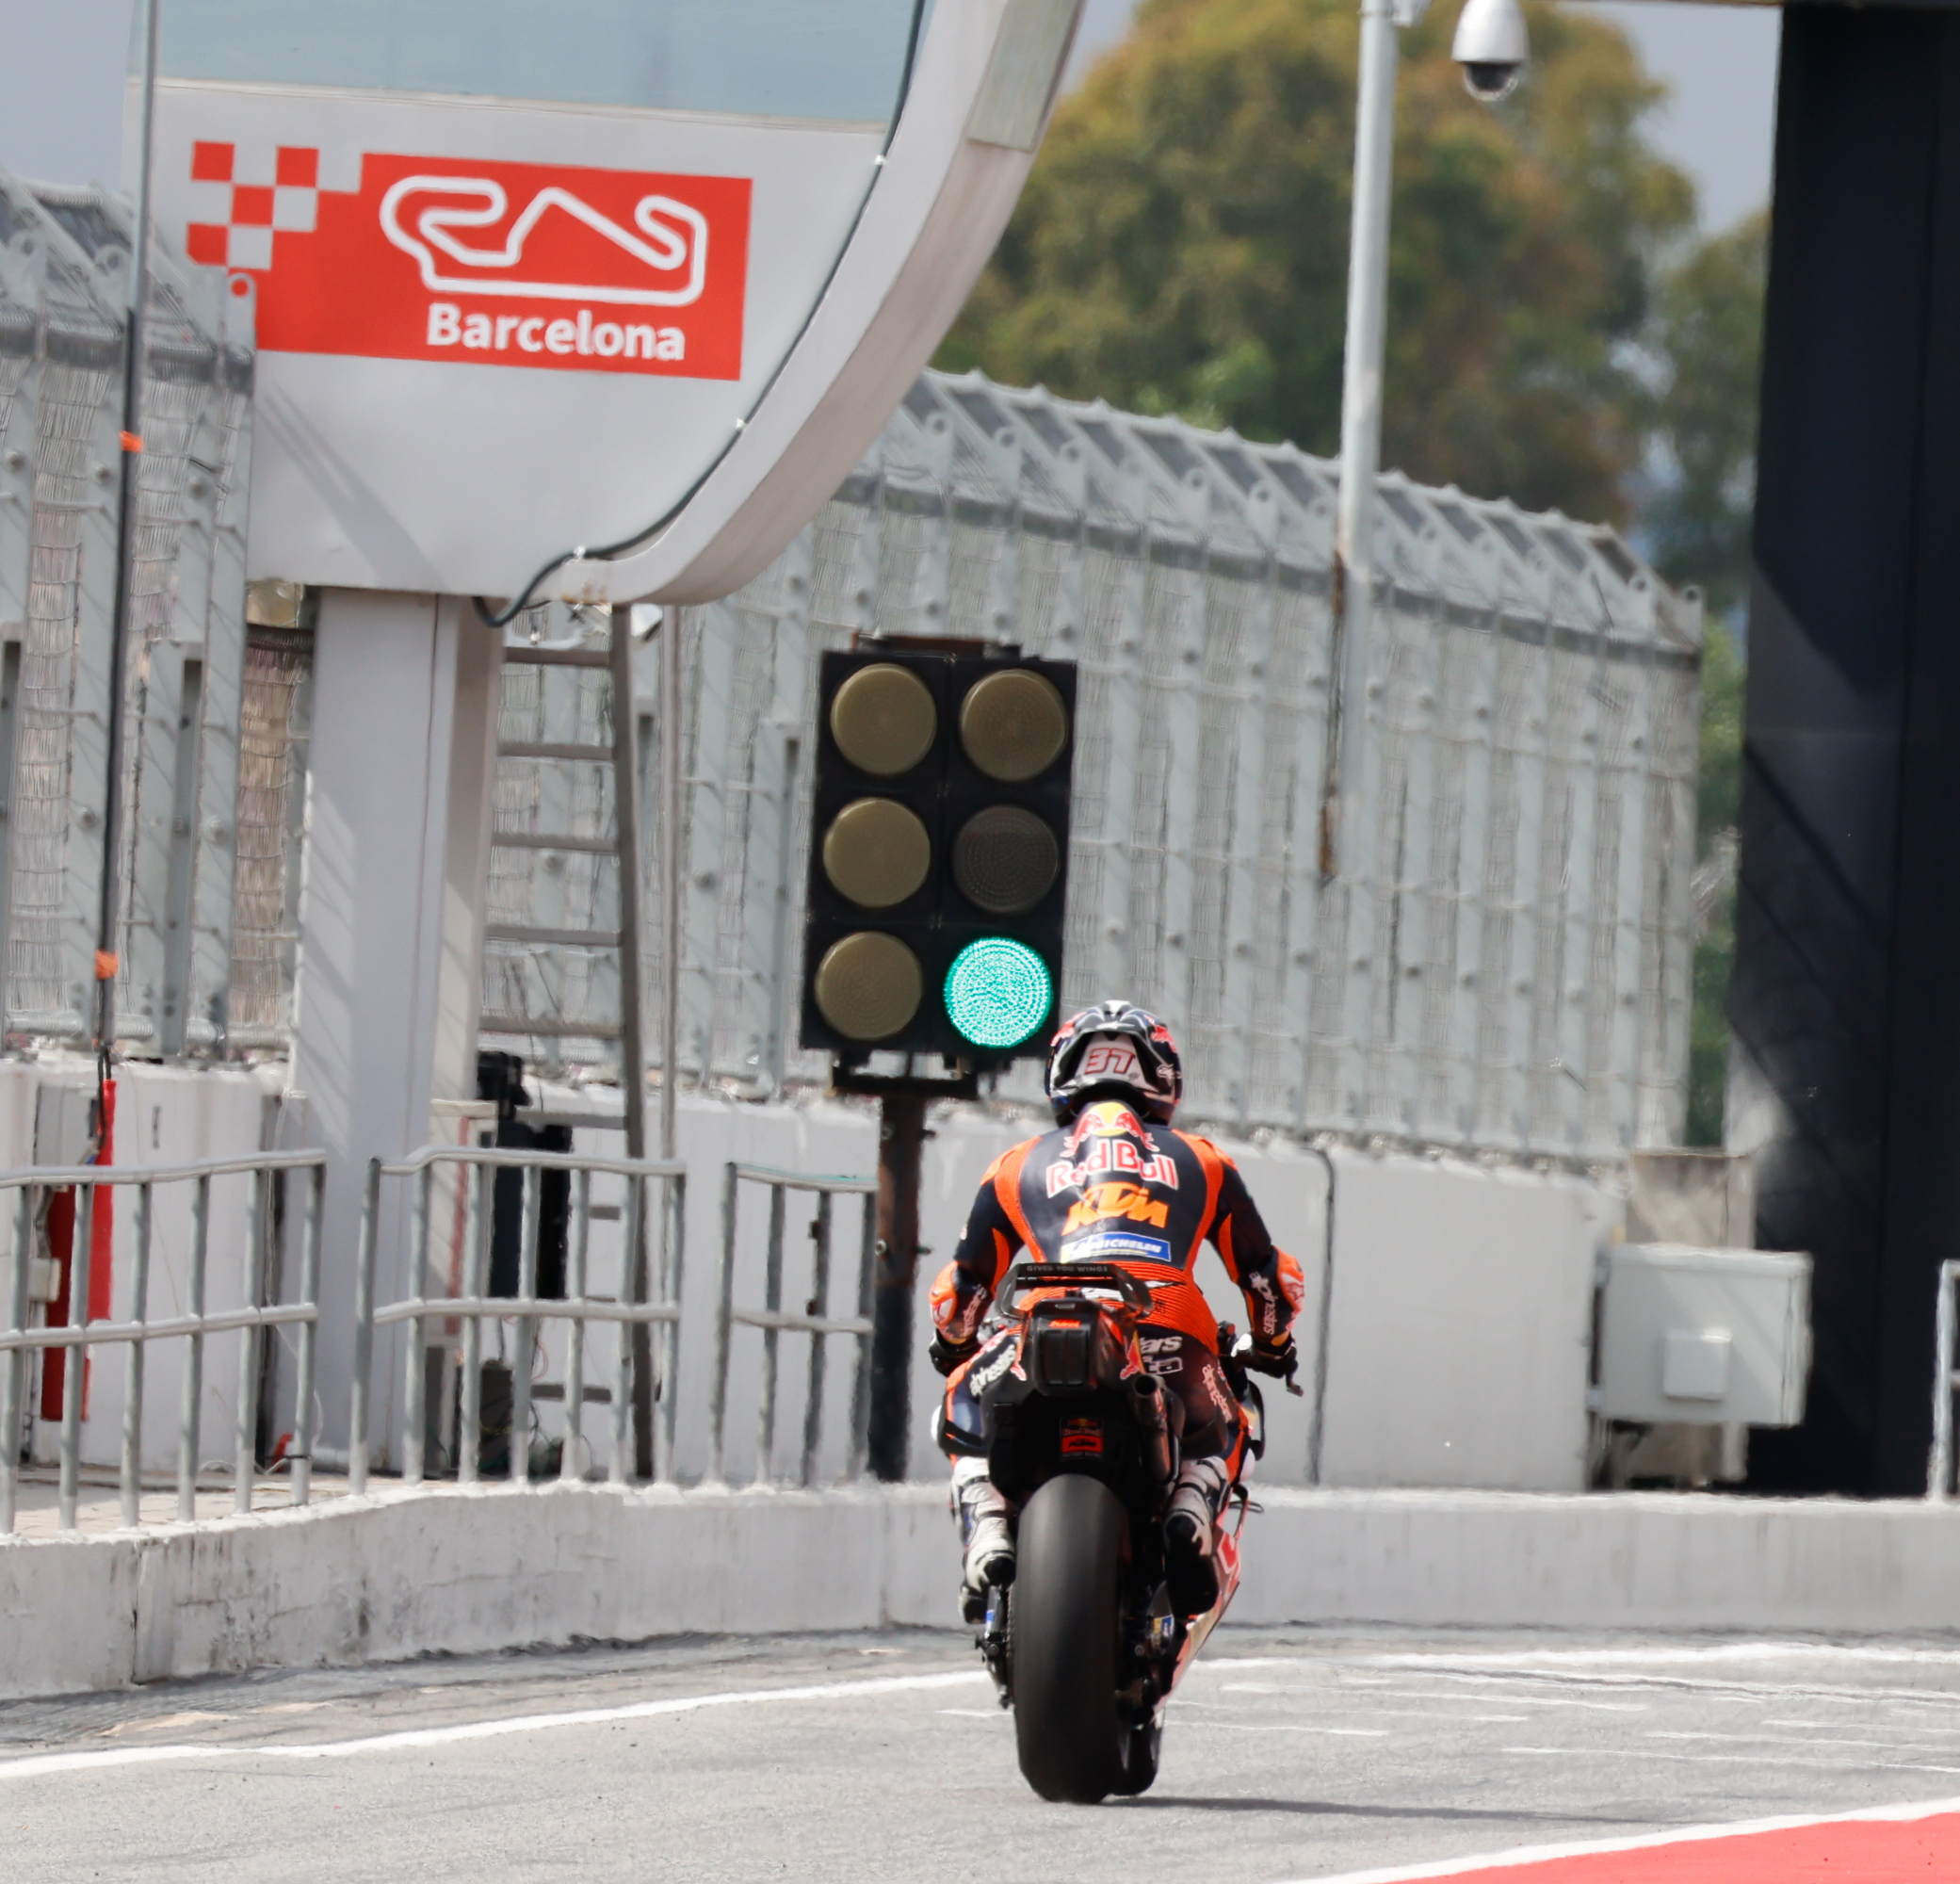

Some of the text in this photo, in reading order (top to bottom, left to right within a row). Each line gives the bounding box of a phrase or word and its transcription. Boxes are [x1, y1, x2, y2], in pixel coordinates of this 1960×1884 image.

[427, 301, 686, 361] Barcelona
[1084, 1047, 1136, 1075] 37
[1045, 1138, 1179, 1199] Red Bull
[1061, 1180, 1169, 1236] KTM
[1090, 1238, 1162, 1254] MICHELIN
